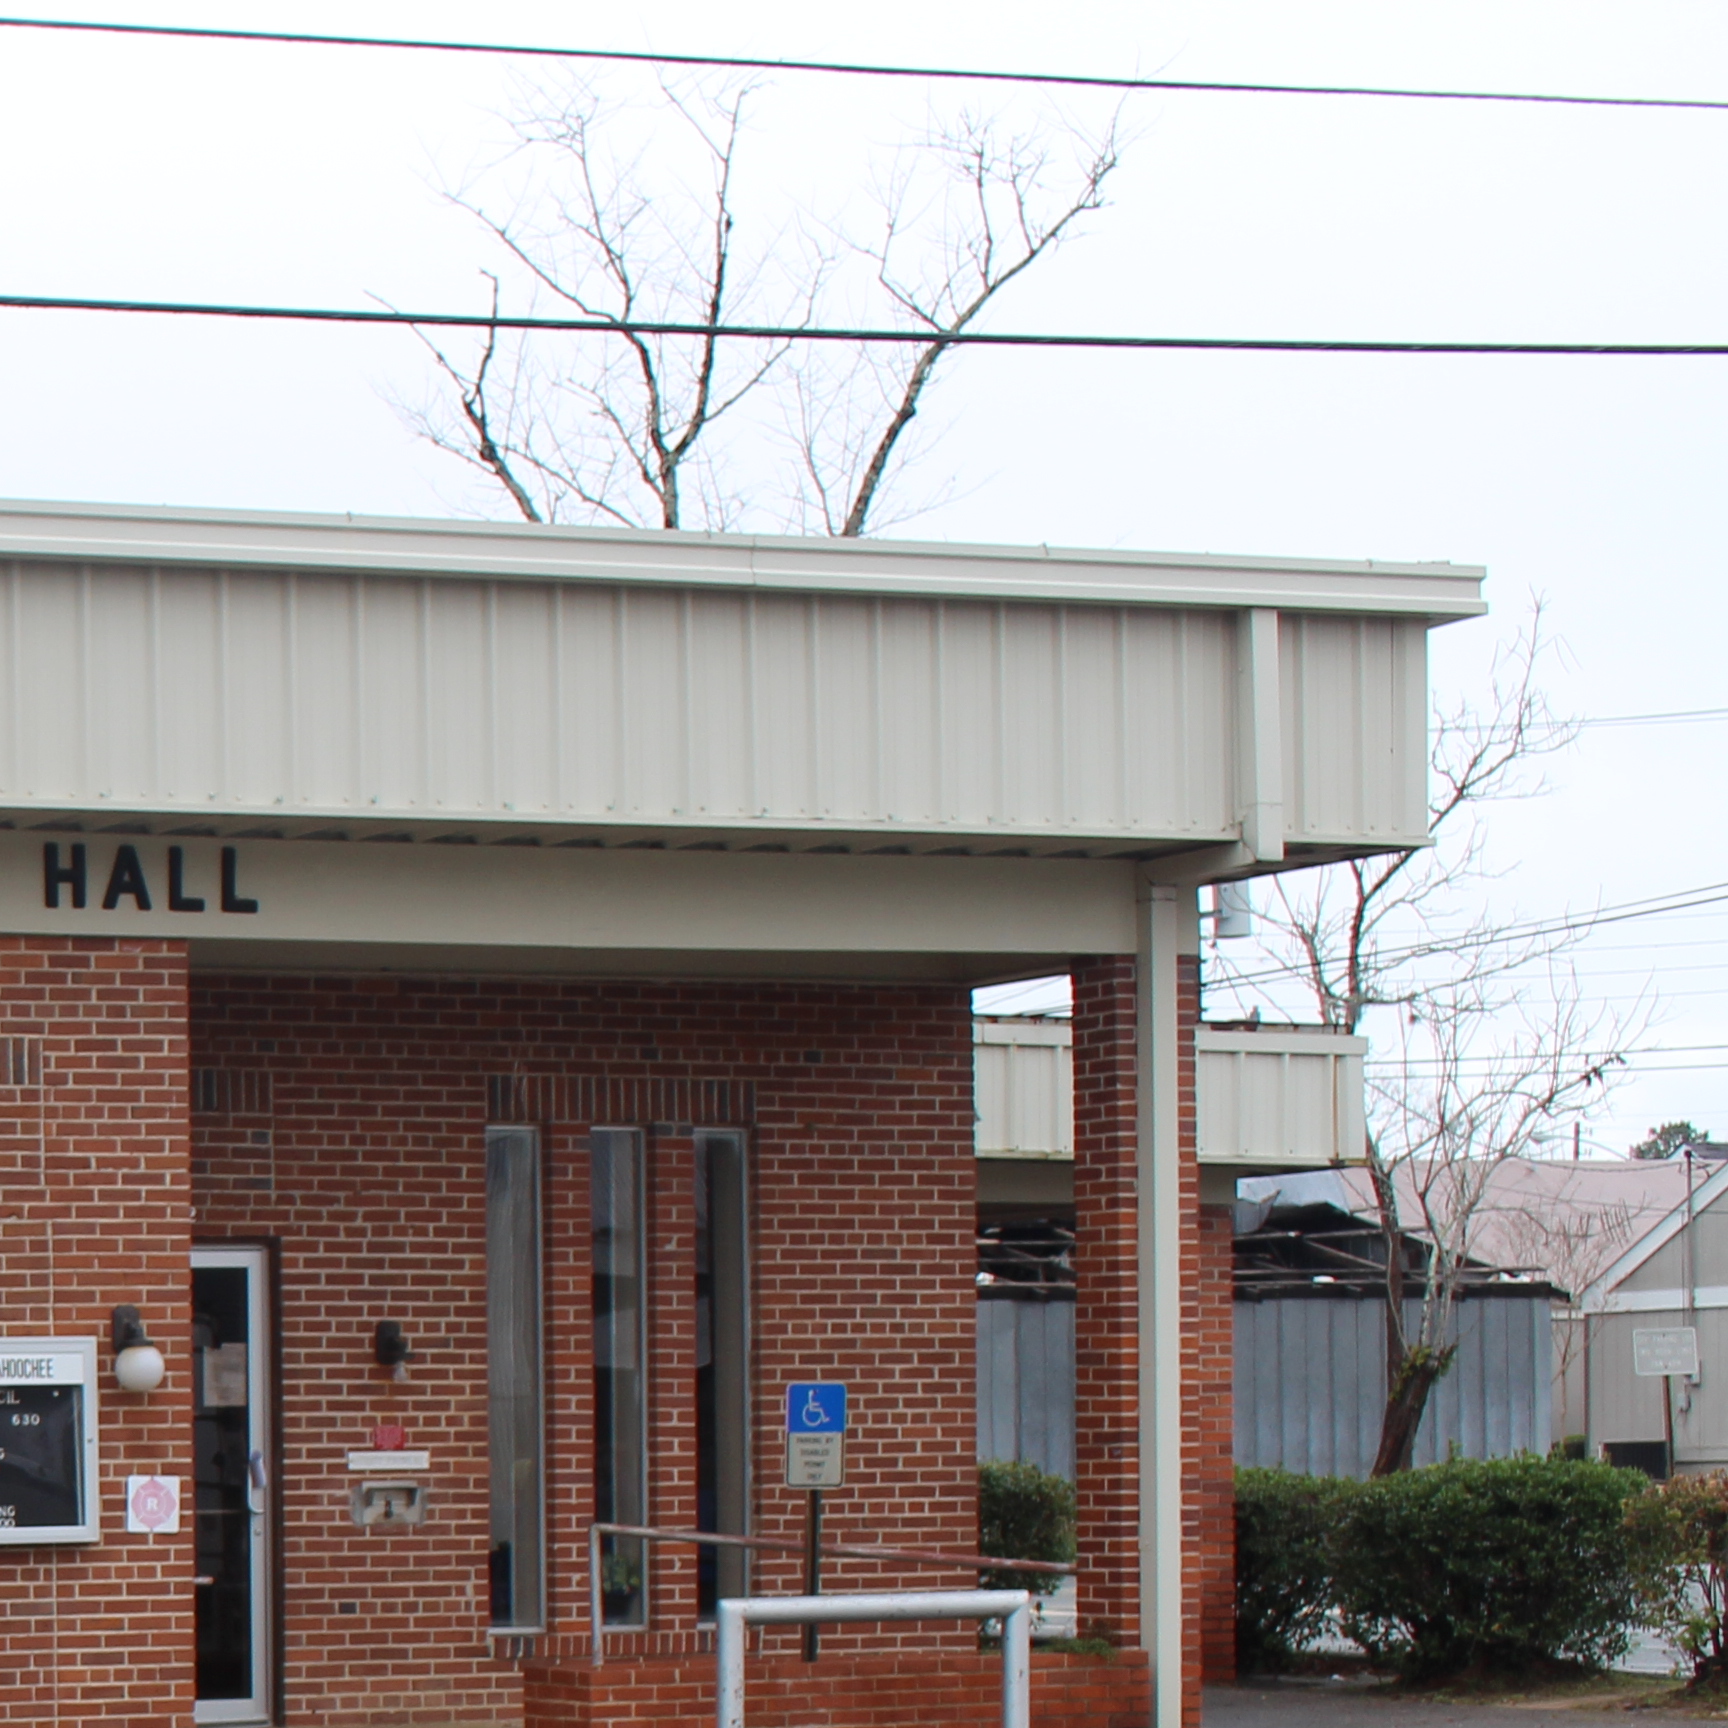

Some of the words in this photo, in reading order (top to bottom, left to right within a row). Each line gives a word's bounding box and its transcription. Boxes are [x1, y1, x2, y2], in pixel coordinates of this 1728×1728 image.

[43, 841, 259, 914] HALL
[11, 1413, 41, 1427] 630
[146, 1497, 159, 1512] R
